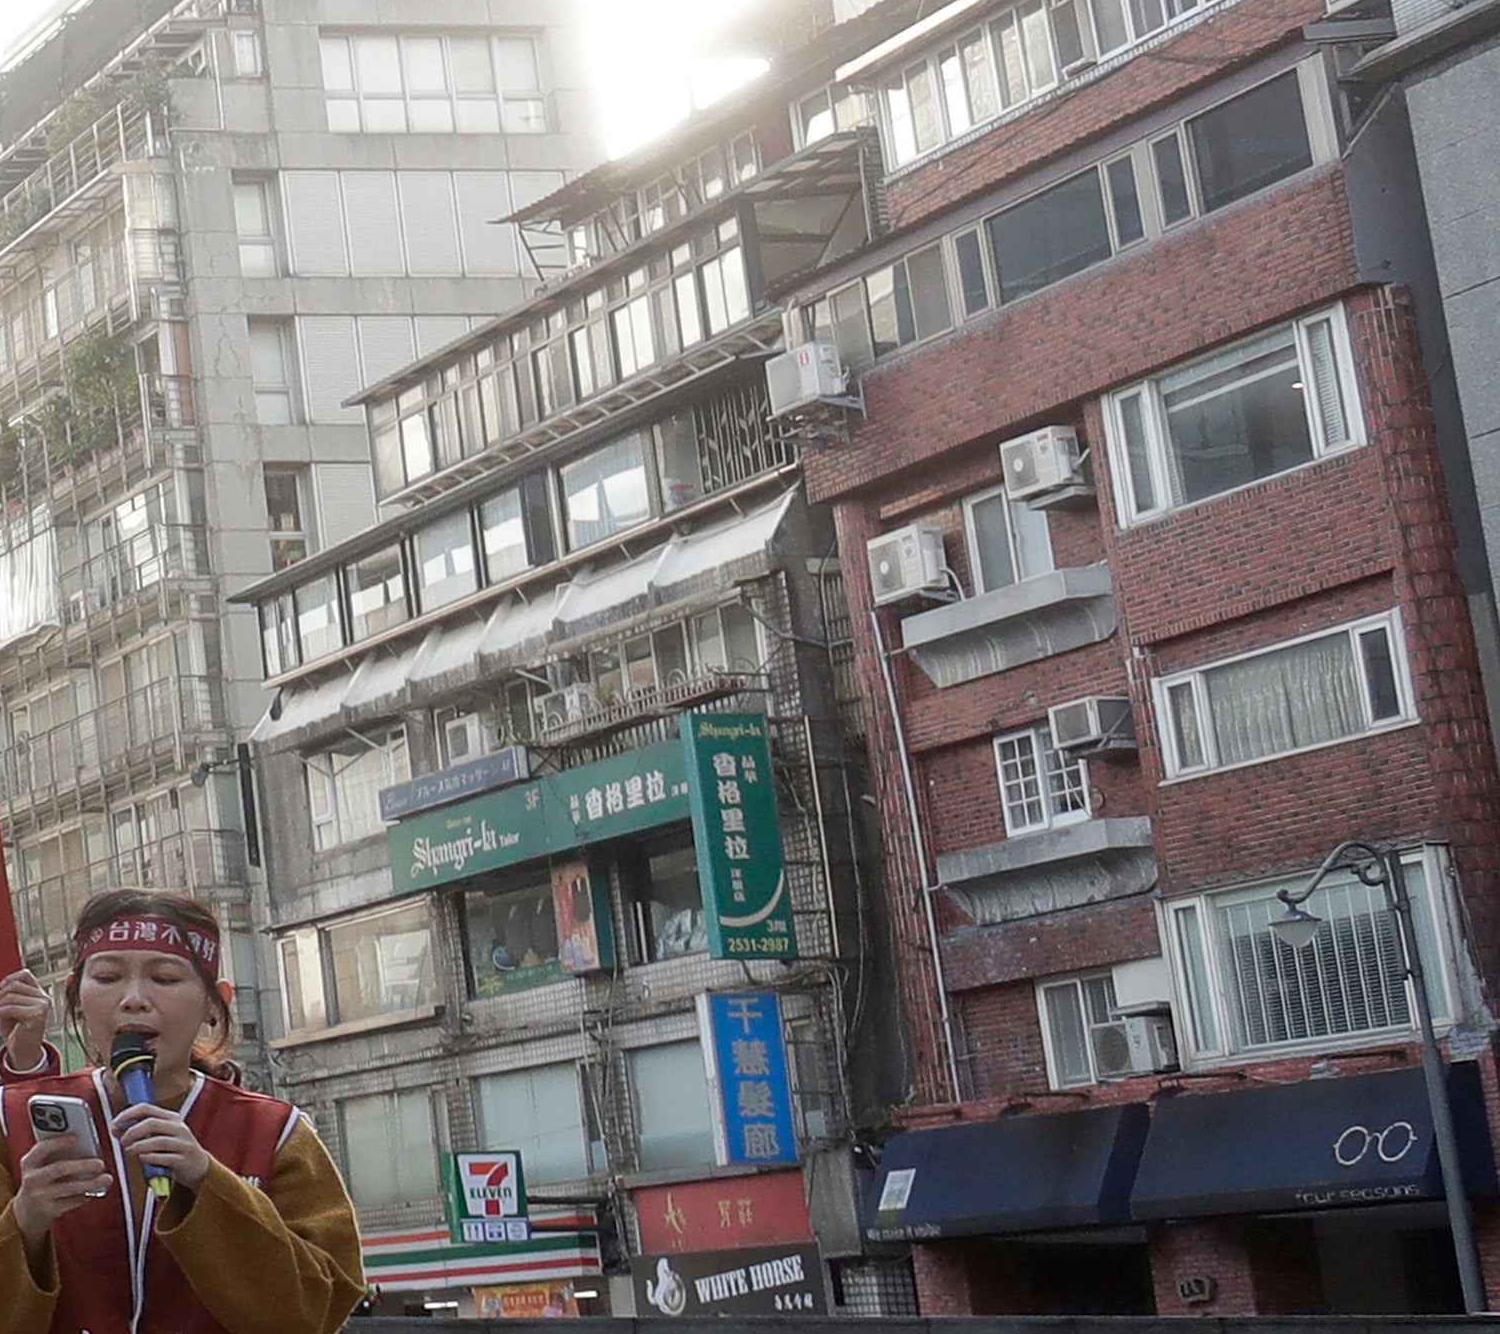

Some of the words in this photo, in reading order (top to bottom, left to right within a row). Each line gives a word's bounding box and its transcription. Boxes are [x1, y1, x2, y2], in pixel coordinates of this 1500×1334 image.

[585, 769, 667, 821] 香格里拉
[712, 752, 750, 860] 香格里拉
[727, 937, 789, 953] 2531-2987
[694, 1268, 749, 1304] WHITE
[749, 1254, 805, 1291] HORSE
